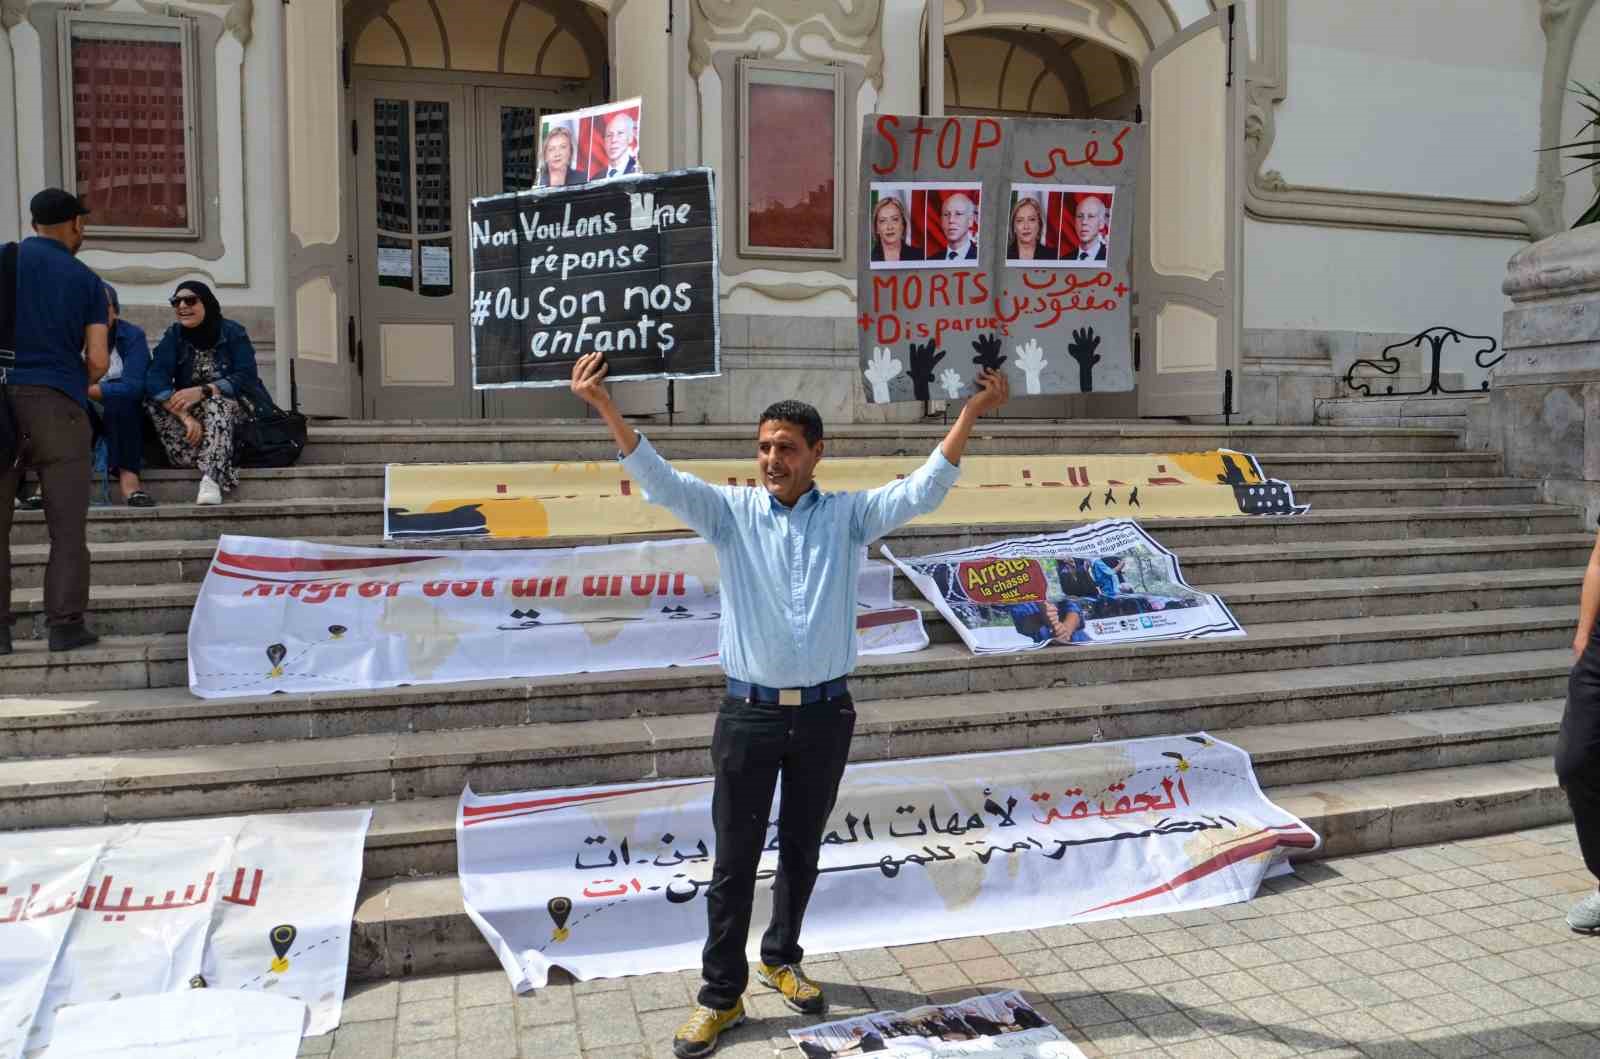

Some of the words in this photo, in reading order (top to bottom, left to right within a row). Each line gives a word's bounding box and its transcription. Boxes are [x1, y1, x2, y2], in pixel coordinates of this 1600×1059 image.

[473, 220, 517, 249] Non
[530, 244, 649, 280] réponse
[623, 282, 692, 313] nos
[872, 271, 990, 312] MORTS
[980, 587, 993, 597] la
[993, 573, 1030, 593] chasse
